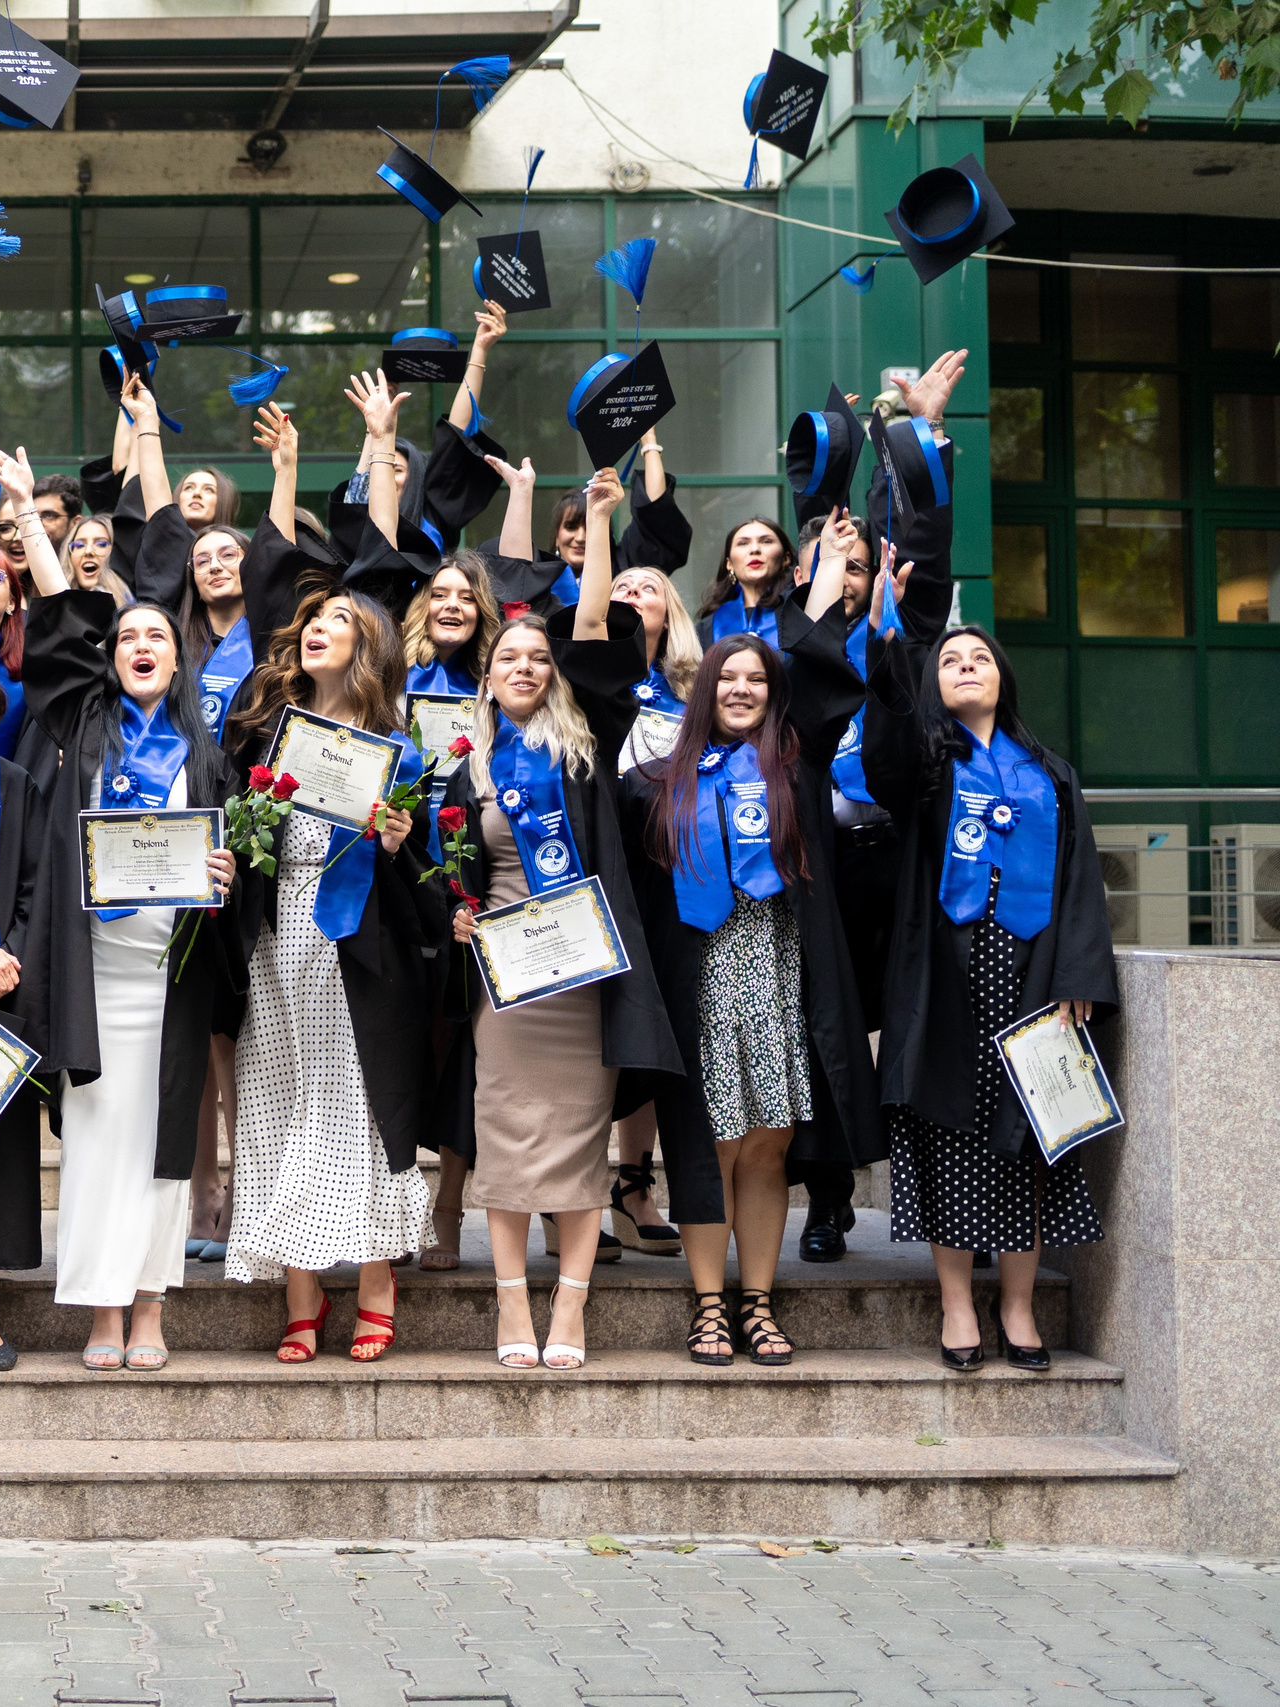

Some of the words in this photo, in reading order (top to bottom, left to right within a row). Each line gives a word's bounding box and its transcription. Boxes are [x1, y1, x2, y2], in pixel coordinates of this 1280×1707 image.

[17, 75, 41, 85] 2024
[780, 86, 796, 103] 2024
[511, 257, 528, 275] 2024
[612, 416, 634, 428] 2024
[451, 721, 473, 732] Diplo
[320, 748, 354, 766] Diplomă
[132, 839, 169, 850] Diplomă
[522, 920, 560, 938] Diplomă
